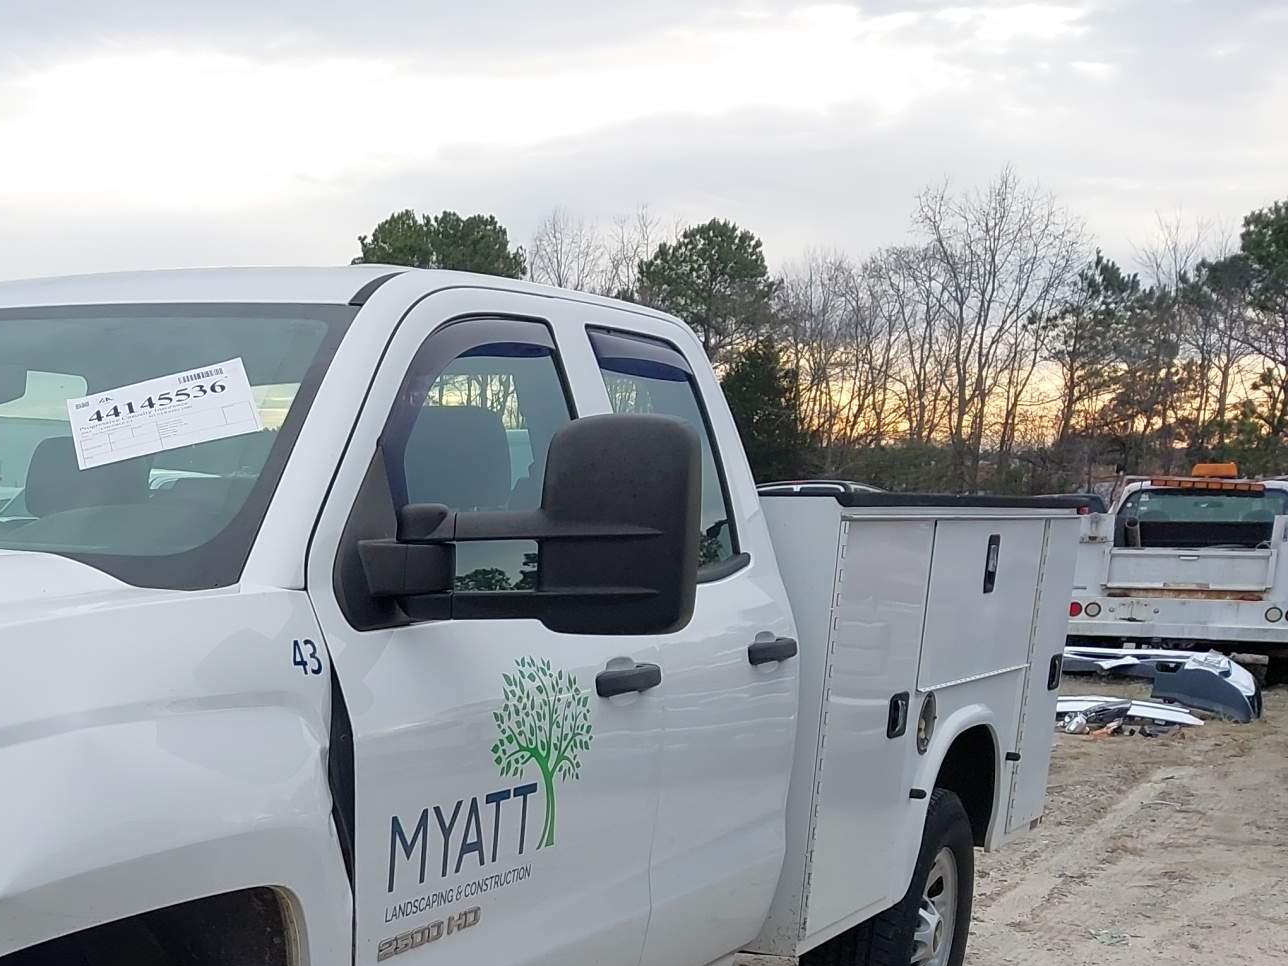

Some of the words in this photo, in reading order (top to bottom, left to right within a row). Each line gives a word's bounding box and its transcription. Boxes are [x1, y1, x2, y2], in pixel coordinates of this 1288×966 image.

[88, 380, 226, 423] 44145536
[292, 639, 322, 675] 43
[388, 783, 538, 893] MYATT
[384, 889, 454, 923] LANDSCAPING
[455, 885, 463, 901] &
[464, 863, 531, 898] CONSTRUCTION
[377, 919, 444, 962] 2500
[447, 906, 481, 935] HD
